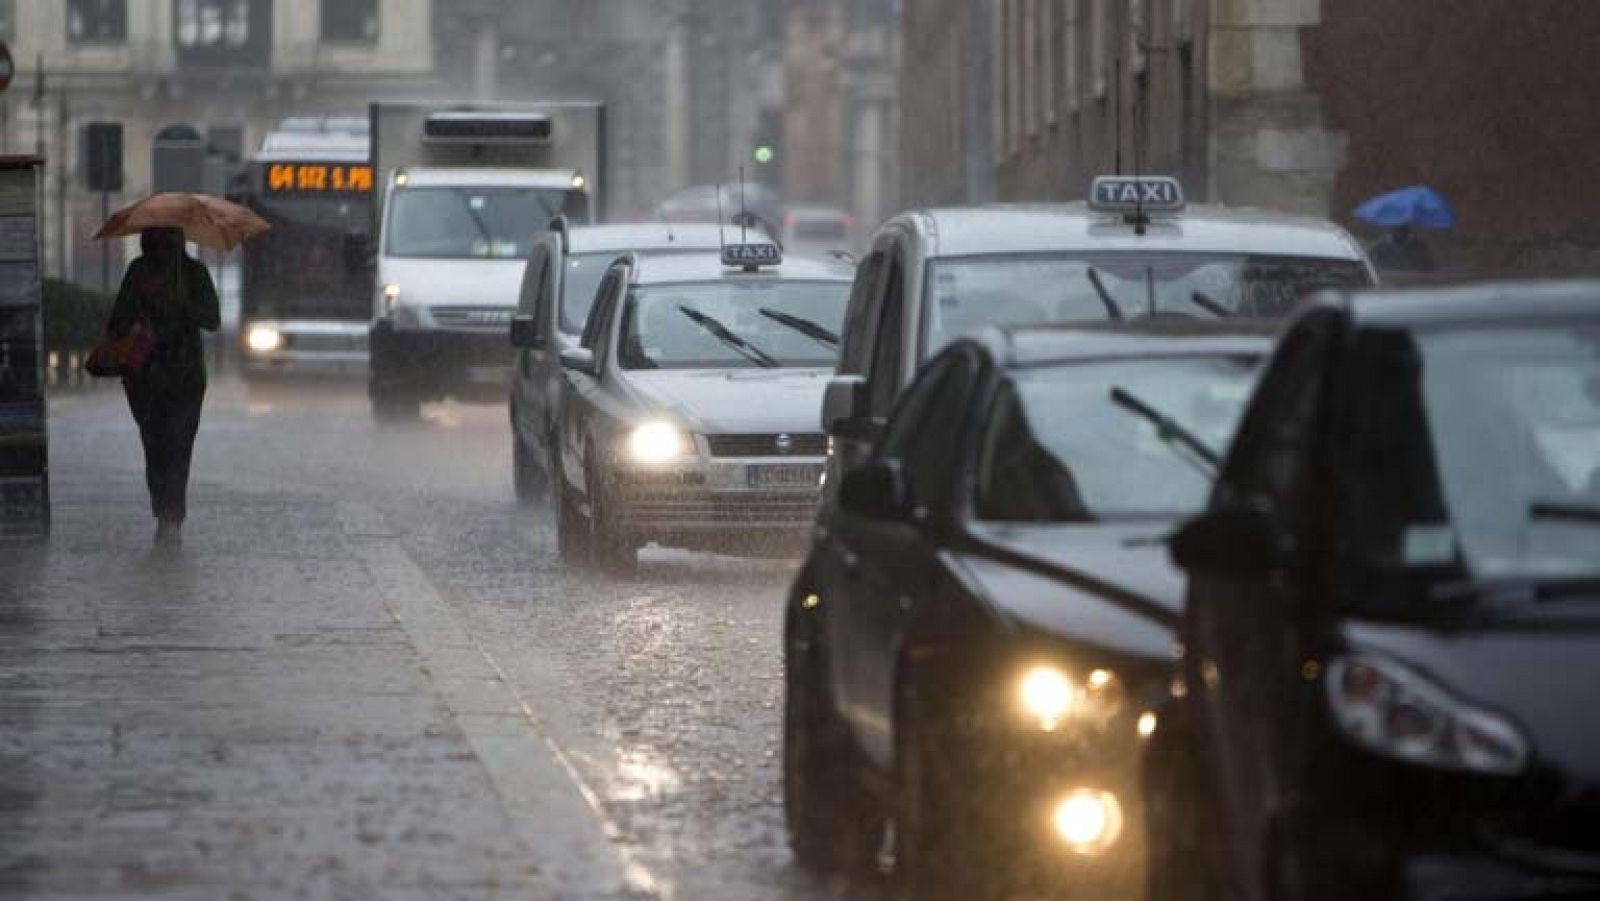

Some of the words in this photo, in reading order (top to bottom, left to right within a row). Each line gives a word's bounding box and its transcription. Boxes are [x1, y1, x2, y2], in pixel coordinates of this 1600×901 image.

[269, 164, 293, 190] 64
[1102, 181, 1171, 201] TAXI
[728, 246, 775, 258] TAXI
